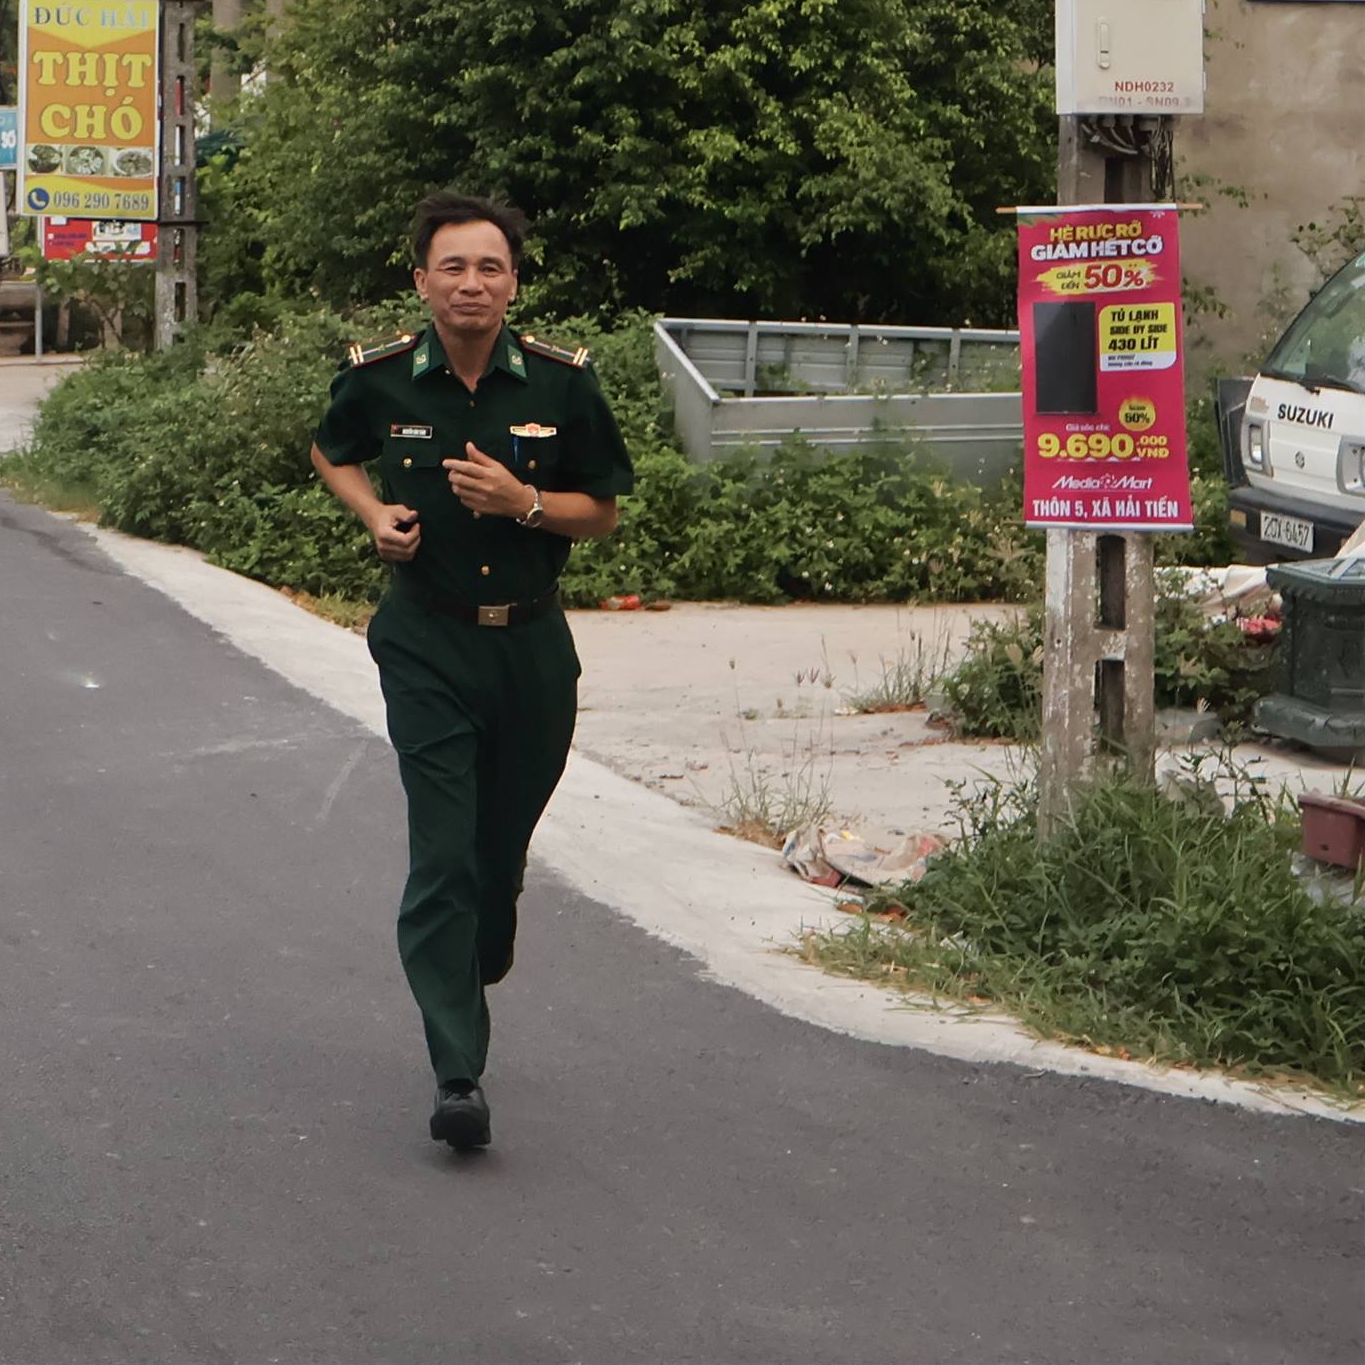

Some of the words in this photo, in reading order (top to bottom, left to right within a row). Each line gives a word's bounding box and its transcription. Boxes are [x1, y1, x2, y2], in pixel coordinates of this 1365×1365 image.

[33, 50, 152, 97] THỊT
[1115, 81, 1174, 92] NDH0232
[41, 96, 143, 140] CHÓ
[53, 191, 80, 209] 096
[84, 192, 110, 209] 290
[114, 193, 150, 211] 7689
[1031, 240, 1089, 261] GIẢM
[1091, 237, 1132, 258] HẾT
[1084, 263, 1145, 290] 50%
[1111, 308, 1126, 322] TỦ
[1129, 309, 1159, 323] LẠNH
[1109, 338, 1137, 351] 430
[1140, 335, 1159, 350] LÍT
[1277, 403, 1334, 430] SUZUKI
[1037, 433, 1135, 459] 9.690
[1051, 475, 1101, 490] Media
[1113, 476, 1153, 490] Mart
[1032, 496, 1071, 517] THÔN
[1091, 496, 1112, 517] XÃ
[1115, 494, 1141, 518] HẢI
[1144, 495, 1179, 518] TIẾN
